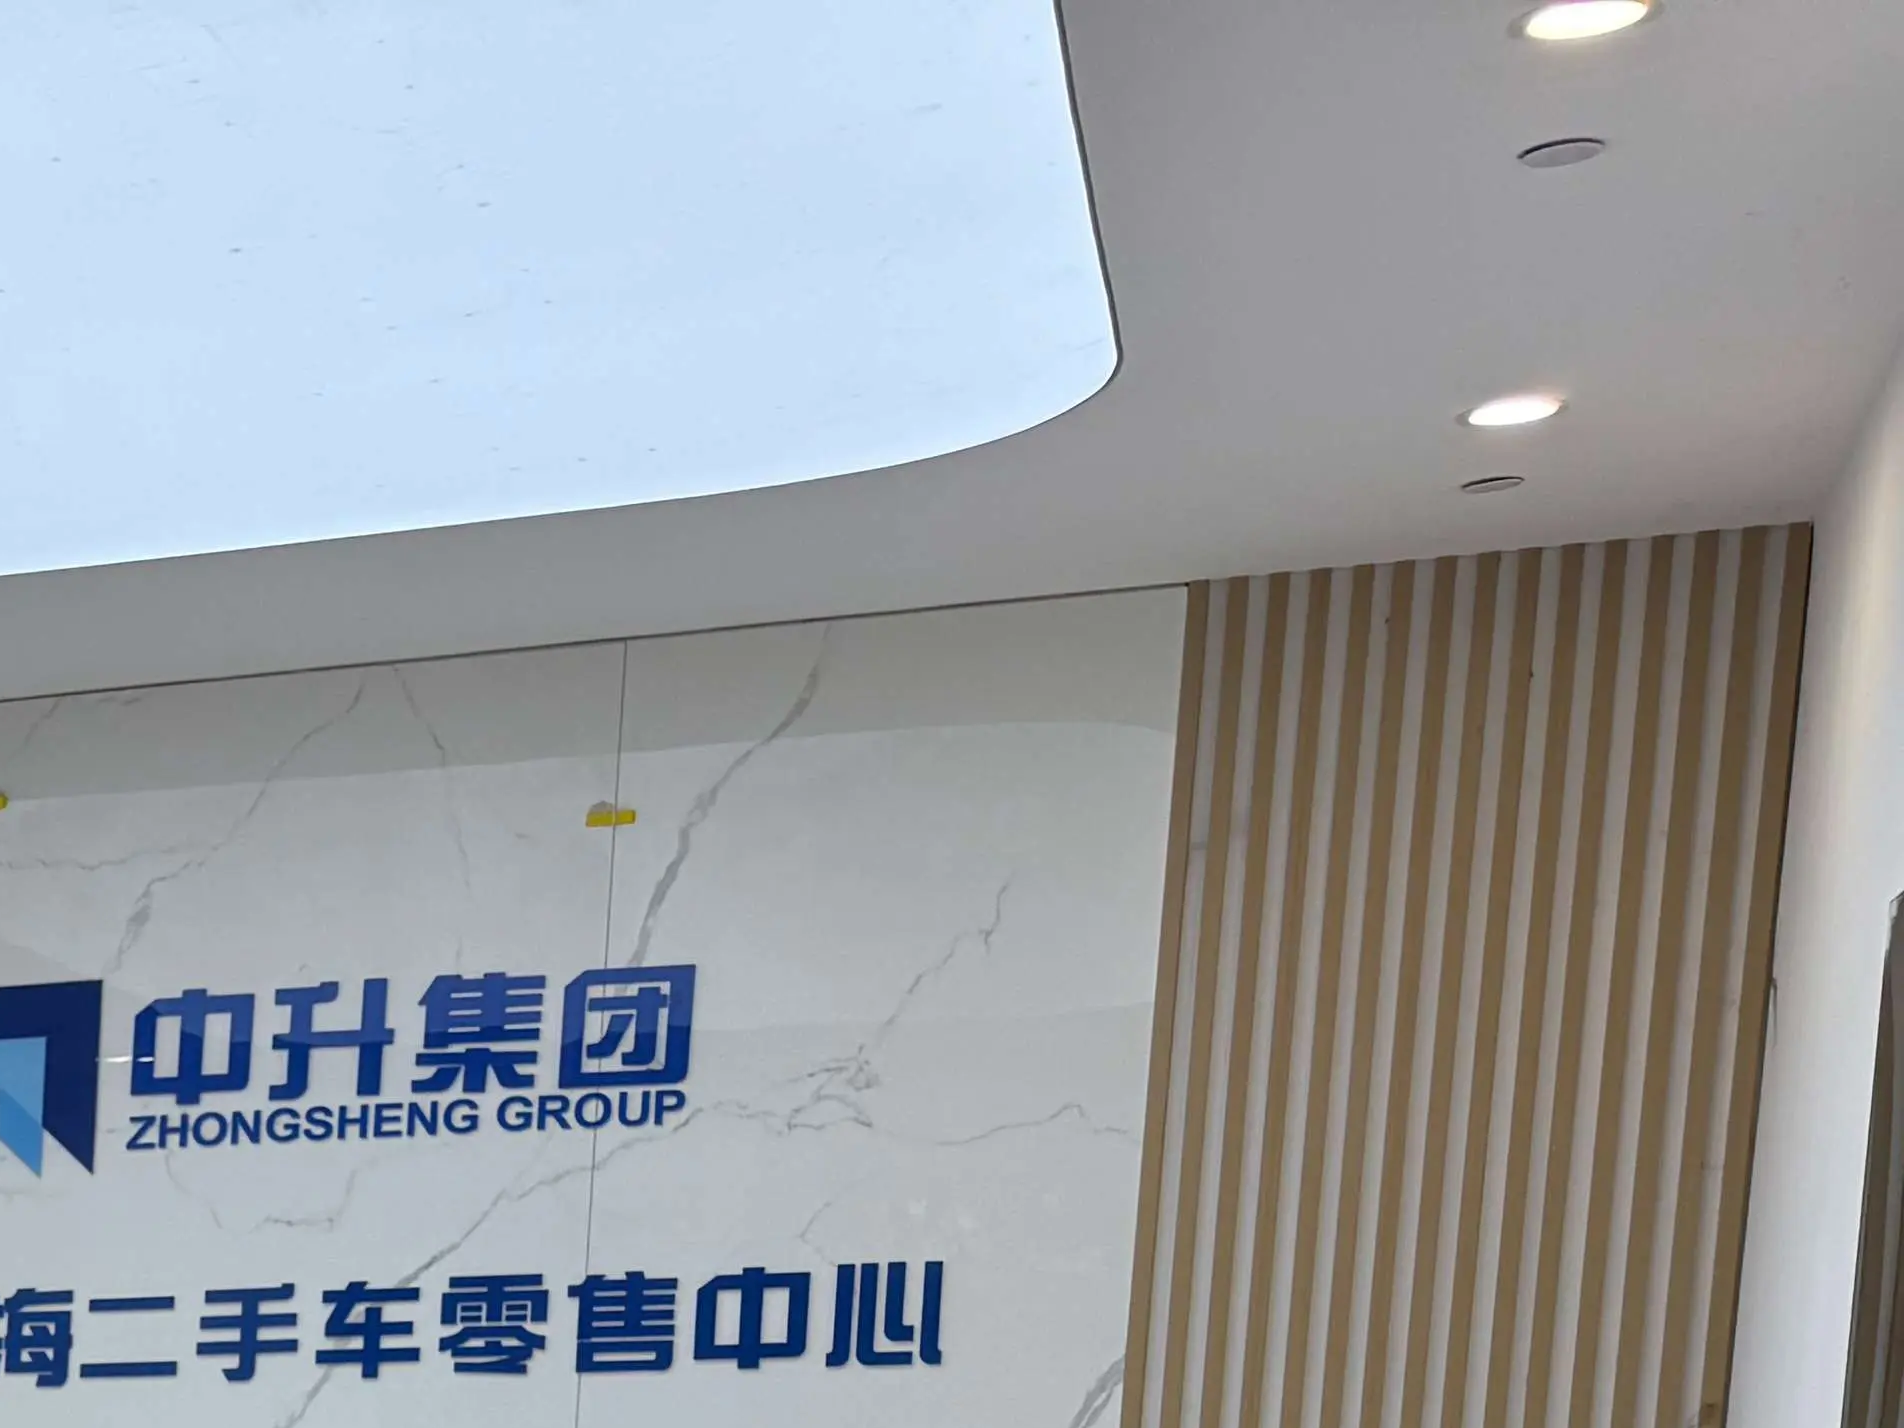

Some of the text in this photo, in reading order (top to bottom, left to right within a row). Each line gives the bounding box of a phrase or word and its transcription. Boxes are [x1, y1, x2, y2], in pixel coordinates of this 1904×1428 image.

[130, 963, 696, 1105] 中升集团
[125, 1089, 687, 1150] ZHONGSHENG GROUP
